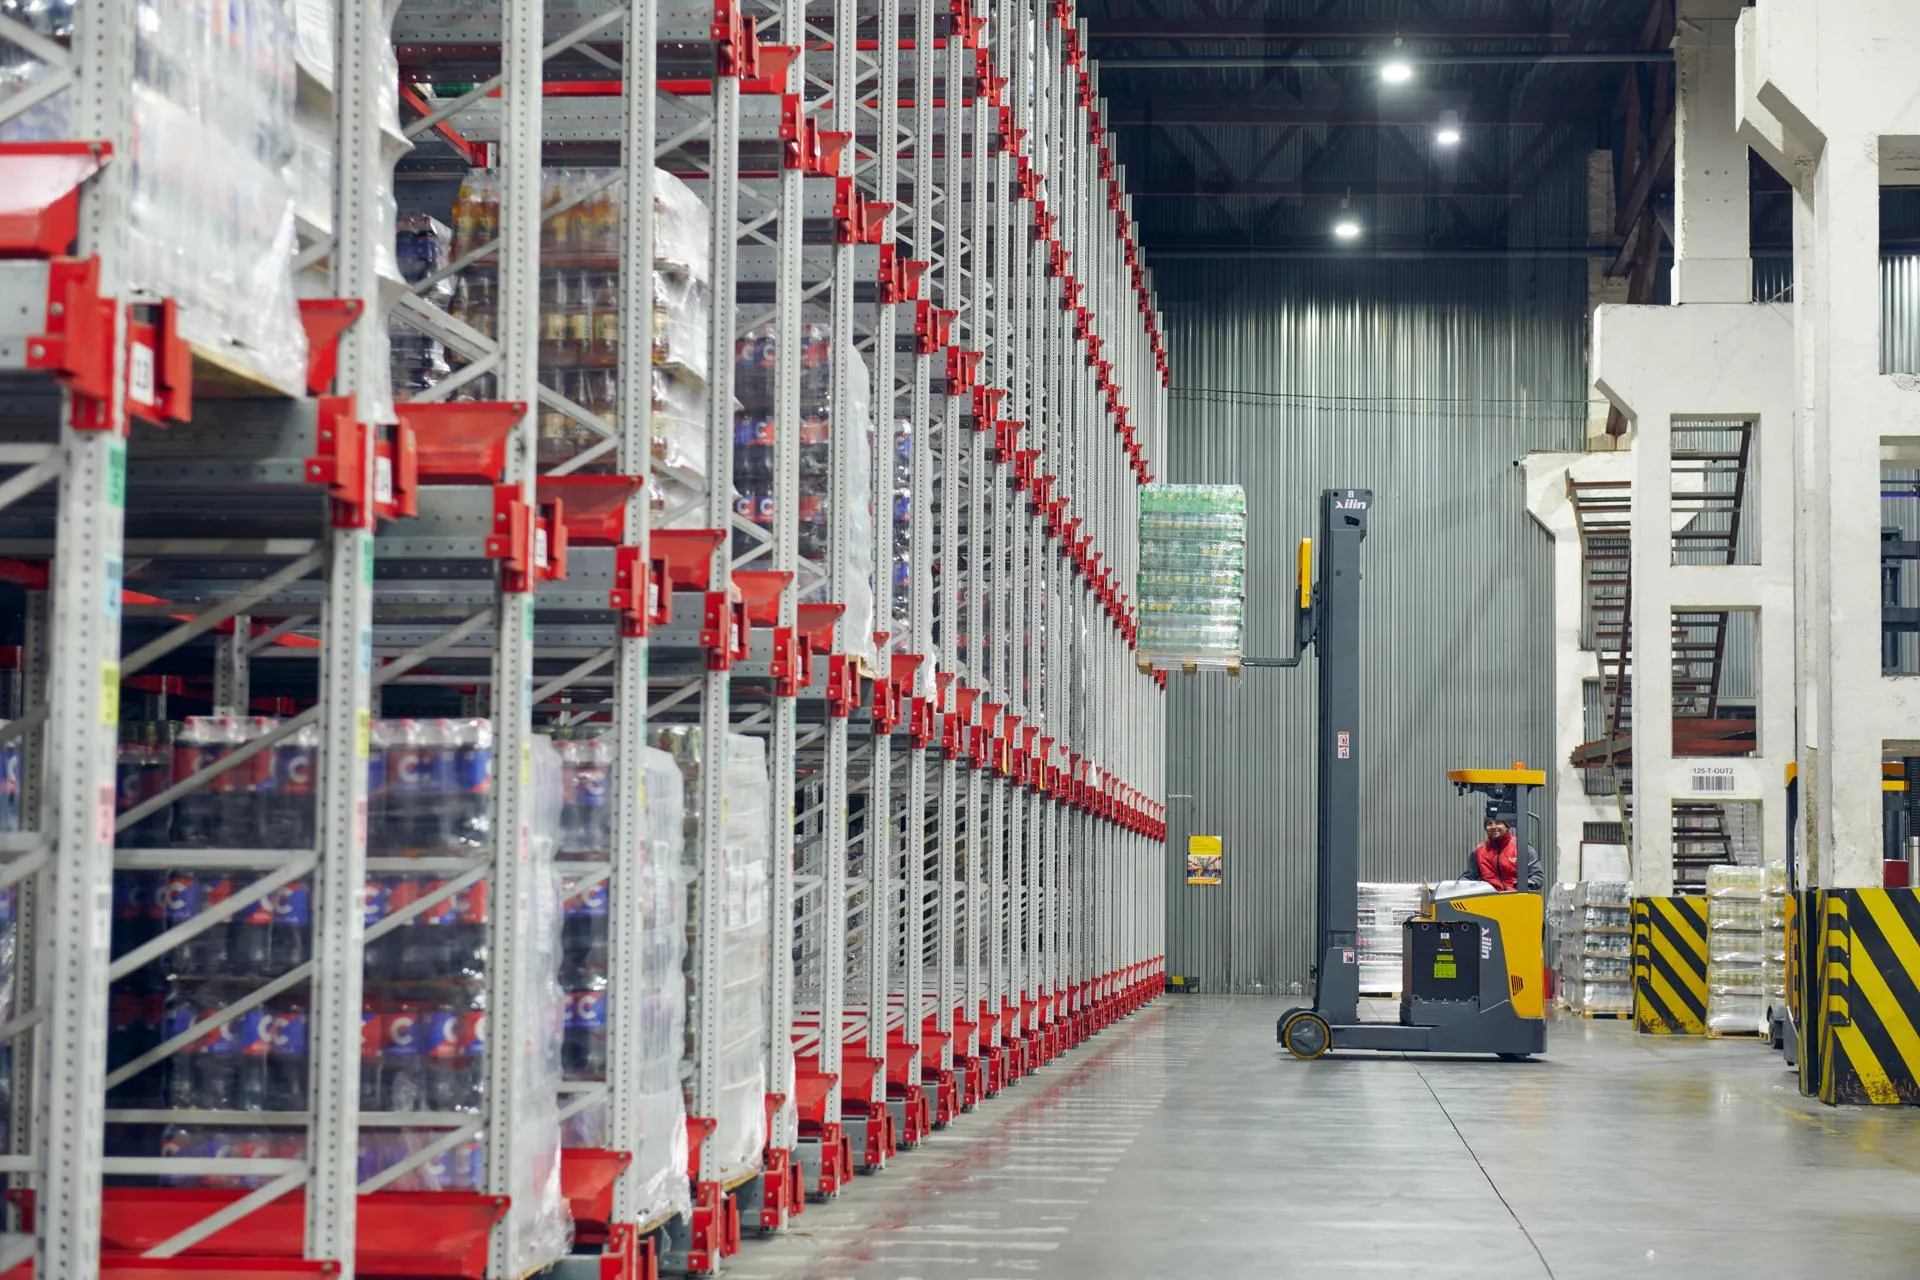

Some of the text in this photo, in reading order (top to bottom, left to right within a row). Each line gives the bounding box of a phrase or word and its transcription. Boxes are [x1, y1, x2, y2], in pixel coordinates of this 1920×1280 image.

[1335, 499, 1367, 510] xilin
[289, 756, 310, 783] C
[398, 755, 420, 783] C
[1481, 927, 1492, 960] xilin
[577, 996, 597, 1019] C
[391, 1017, 413, 1045] C
